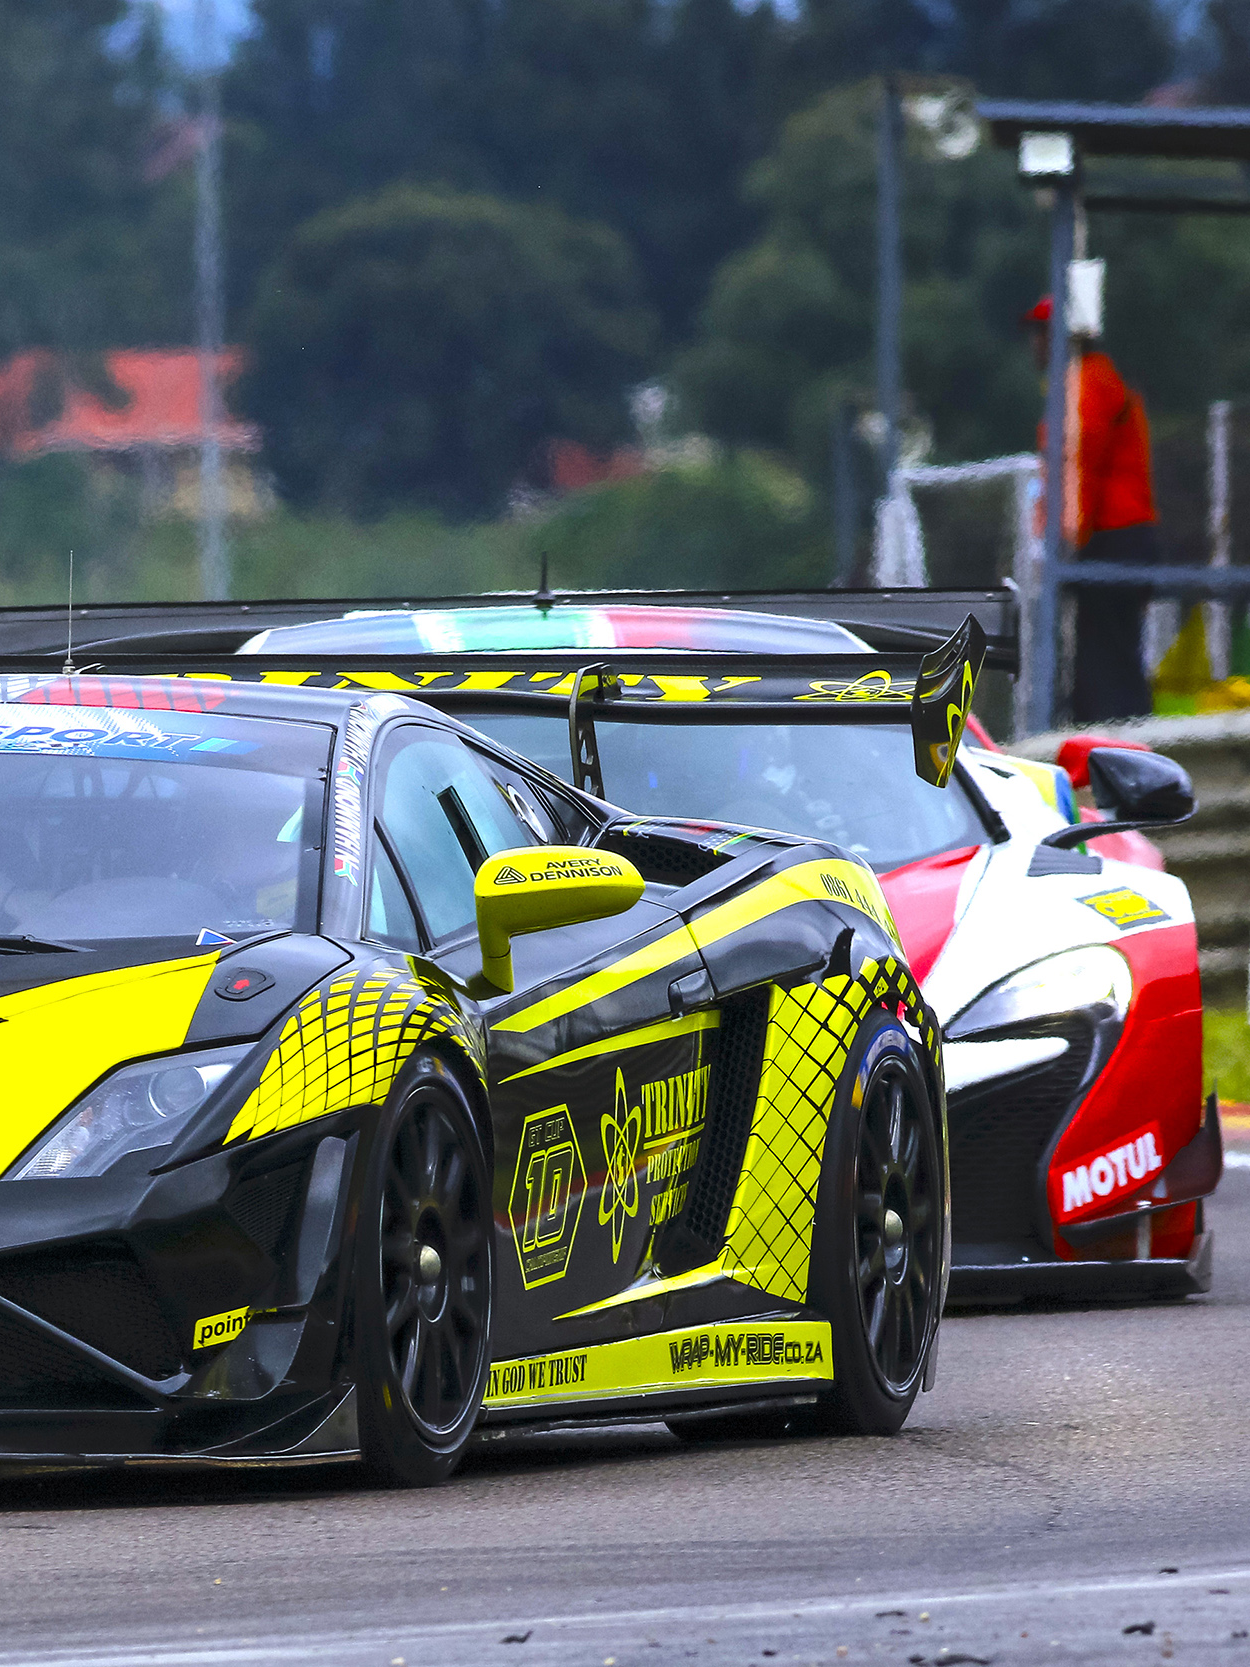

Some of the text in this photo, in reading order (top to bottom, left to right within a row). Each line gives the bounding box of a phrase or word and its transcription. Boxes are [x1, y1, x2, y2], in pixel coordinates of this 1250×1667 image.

[530, 865, 623, 882] DENNISON
[546, 858, 601, 869] AVERY
[641, 1063, 711, 1138] TRINITY
[523, 1140, 575, 1253] 10
[1062, 1132, 1162, 1213] MOTUL
[486, 1354, 588, 1397] IN GOD WE TRUST
